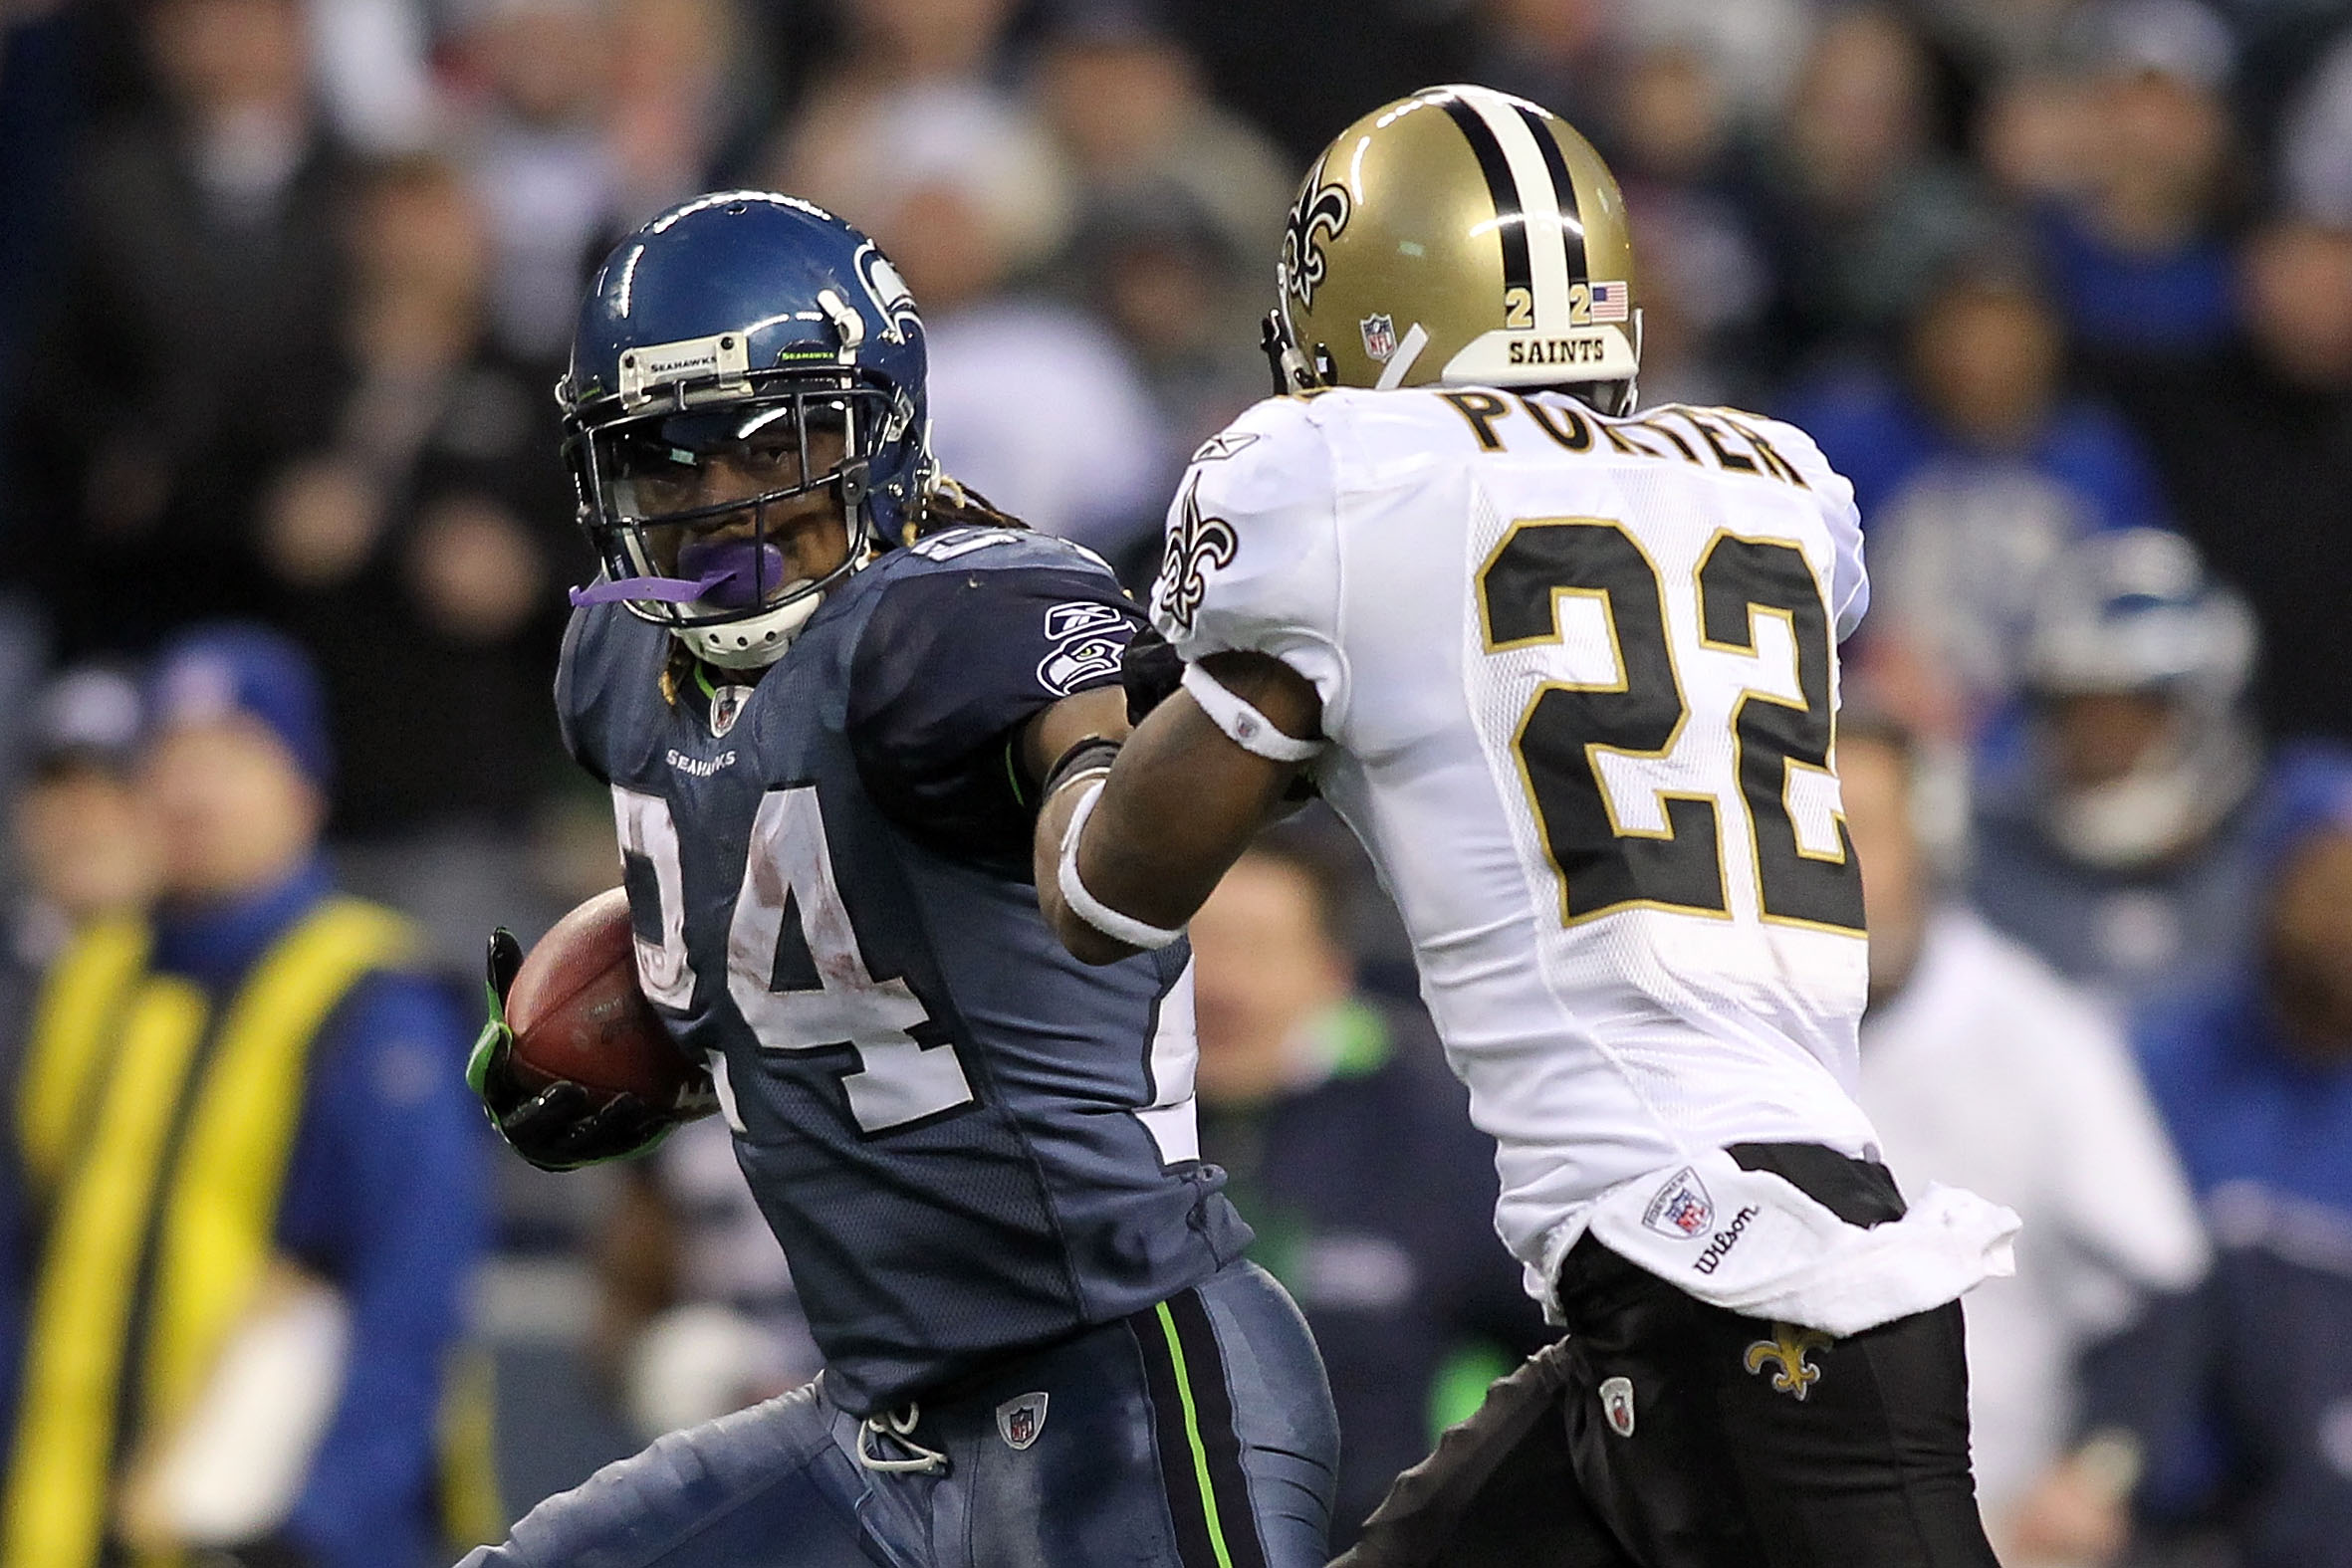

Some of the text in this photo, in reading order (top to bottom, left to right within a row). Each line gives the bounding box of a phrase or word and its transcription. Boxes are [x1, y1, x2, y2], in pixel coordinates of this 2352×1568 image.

[782, 351, 834, 360] SEAHAWKS
[1510, 337, 1604, 364] SAINTS
[1475, 516, 1868, 939] 22
[1693, 1205, 1761, 1275] Wilson
